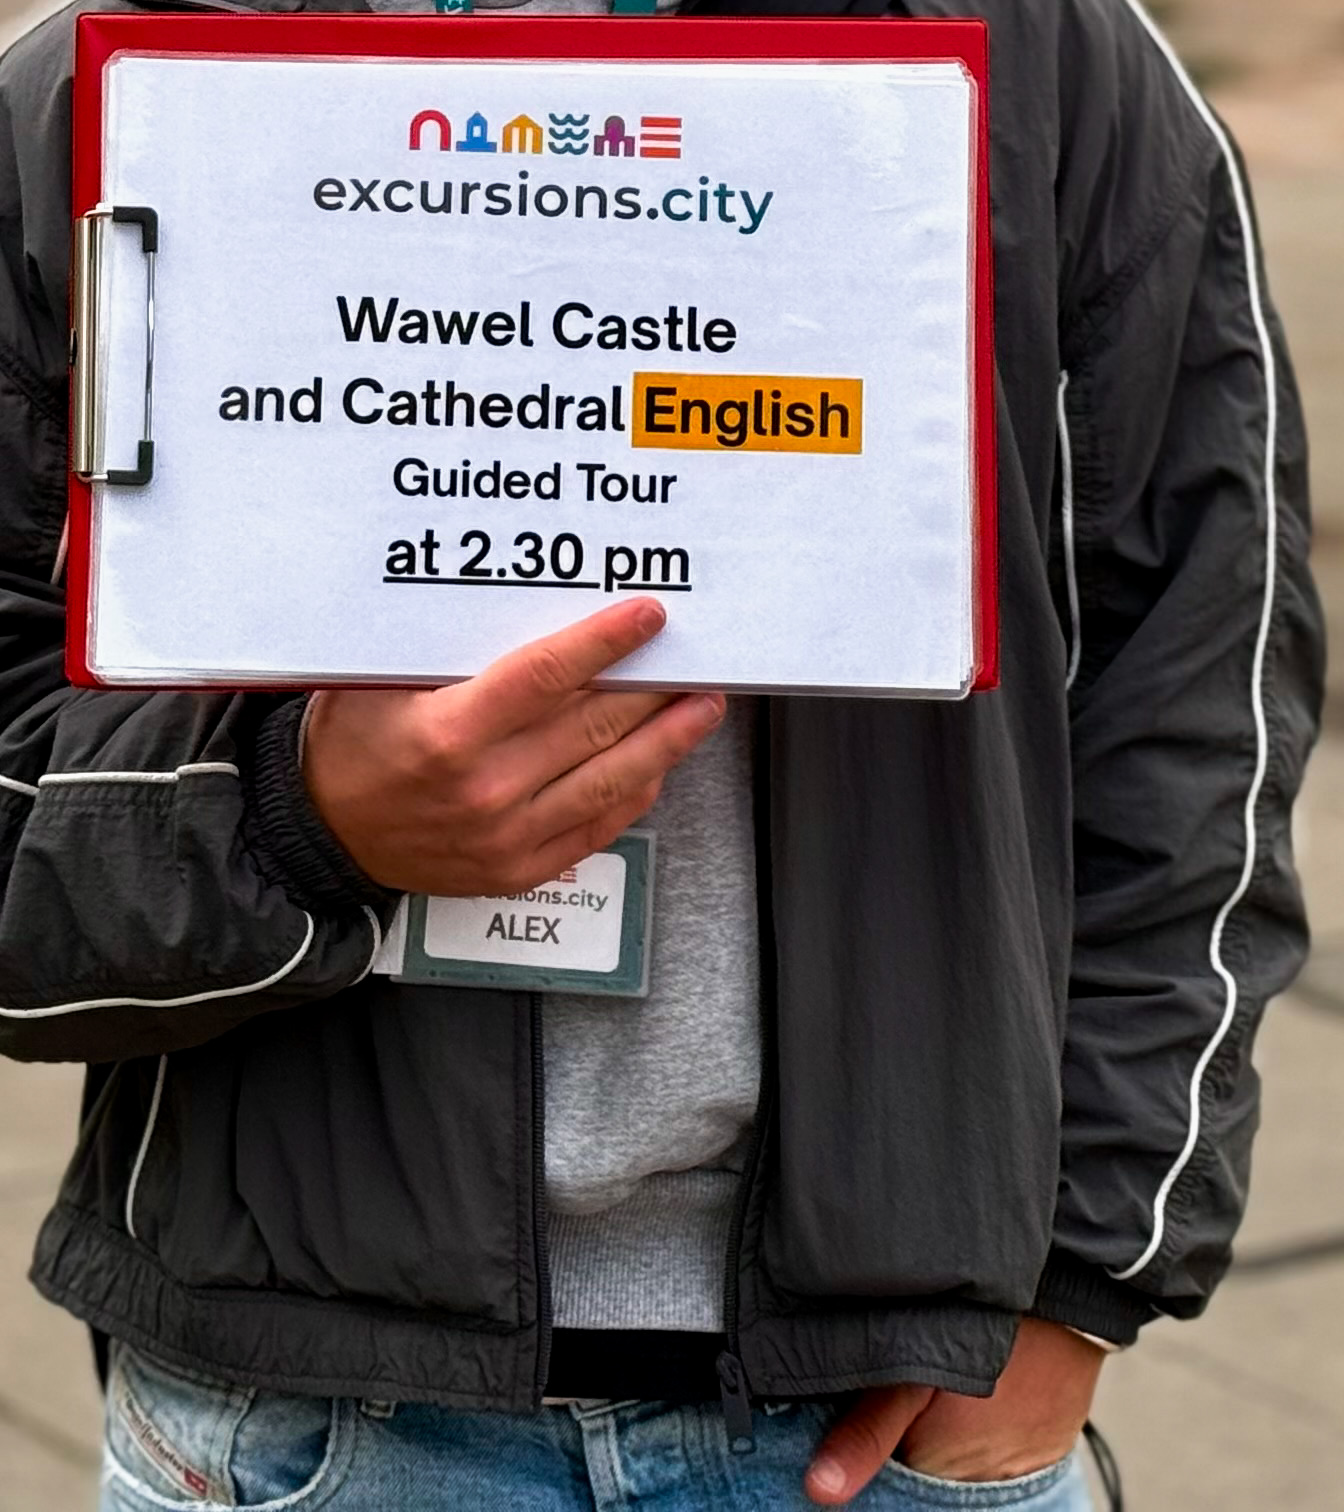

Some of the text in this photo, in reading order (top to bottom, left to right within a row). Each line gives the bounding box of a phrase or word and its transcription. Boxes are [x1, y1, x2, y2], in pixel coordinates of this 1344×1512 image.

[312, 169, 775, 236] excursions.city
[336, 294, 738, 355] Wawel Castle
[217, 375, 851, 448] and Cathedral English
[392, 456, 679, 505] Guided Tour
[384, 528, 693, 593] at 2.30 pm
[485, 911, 562, 945] ALEX
